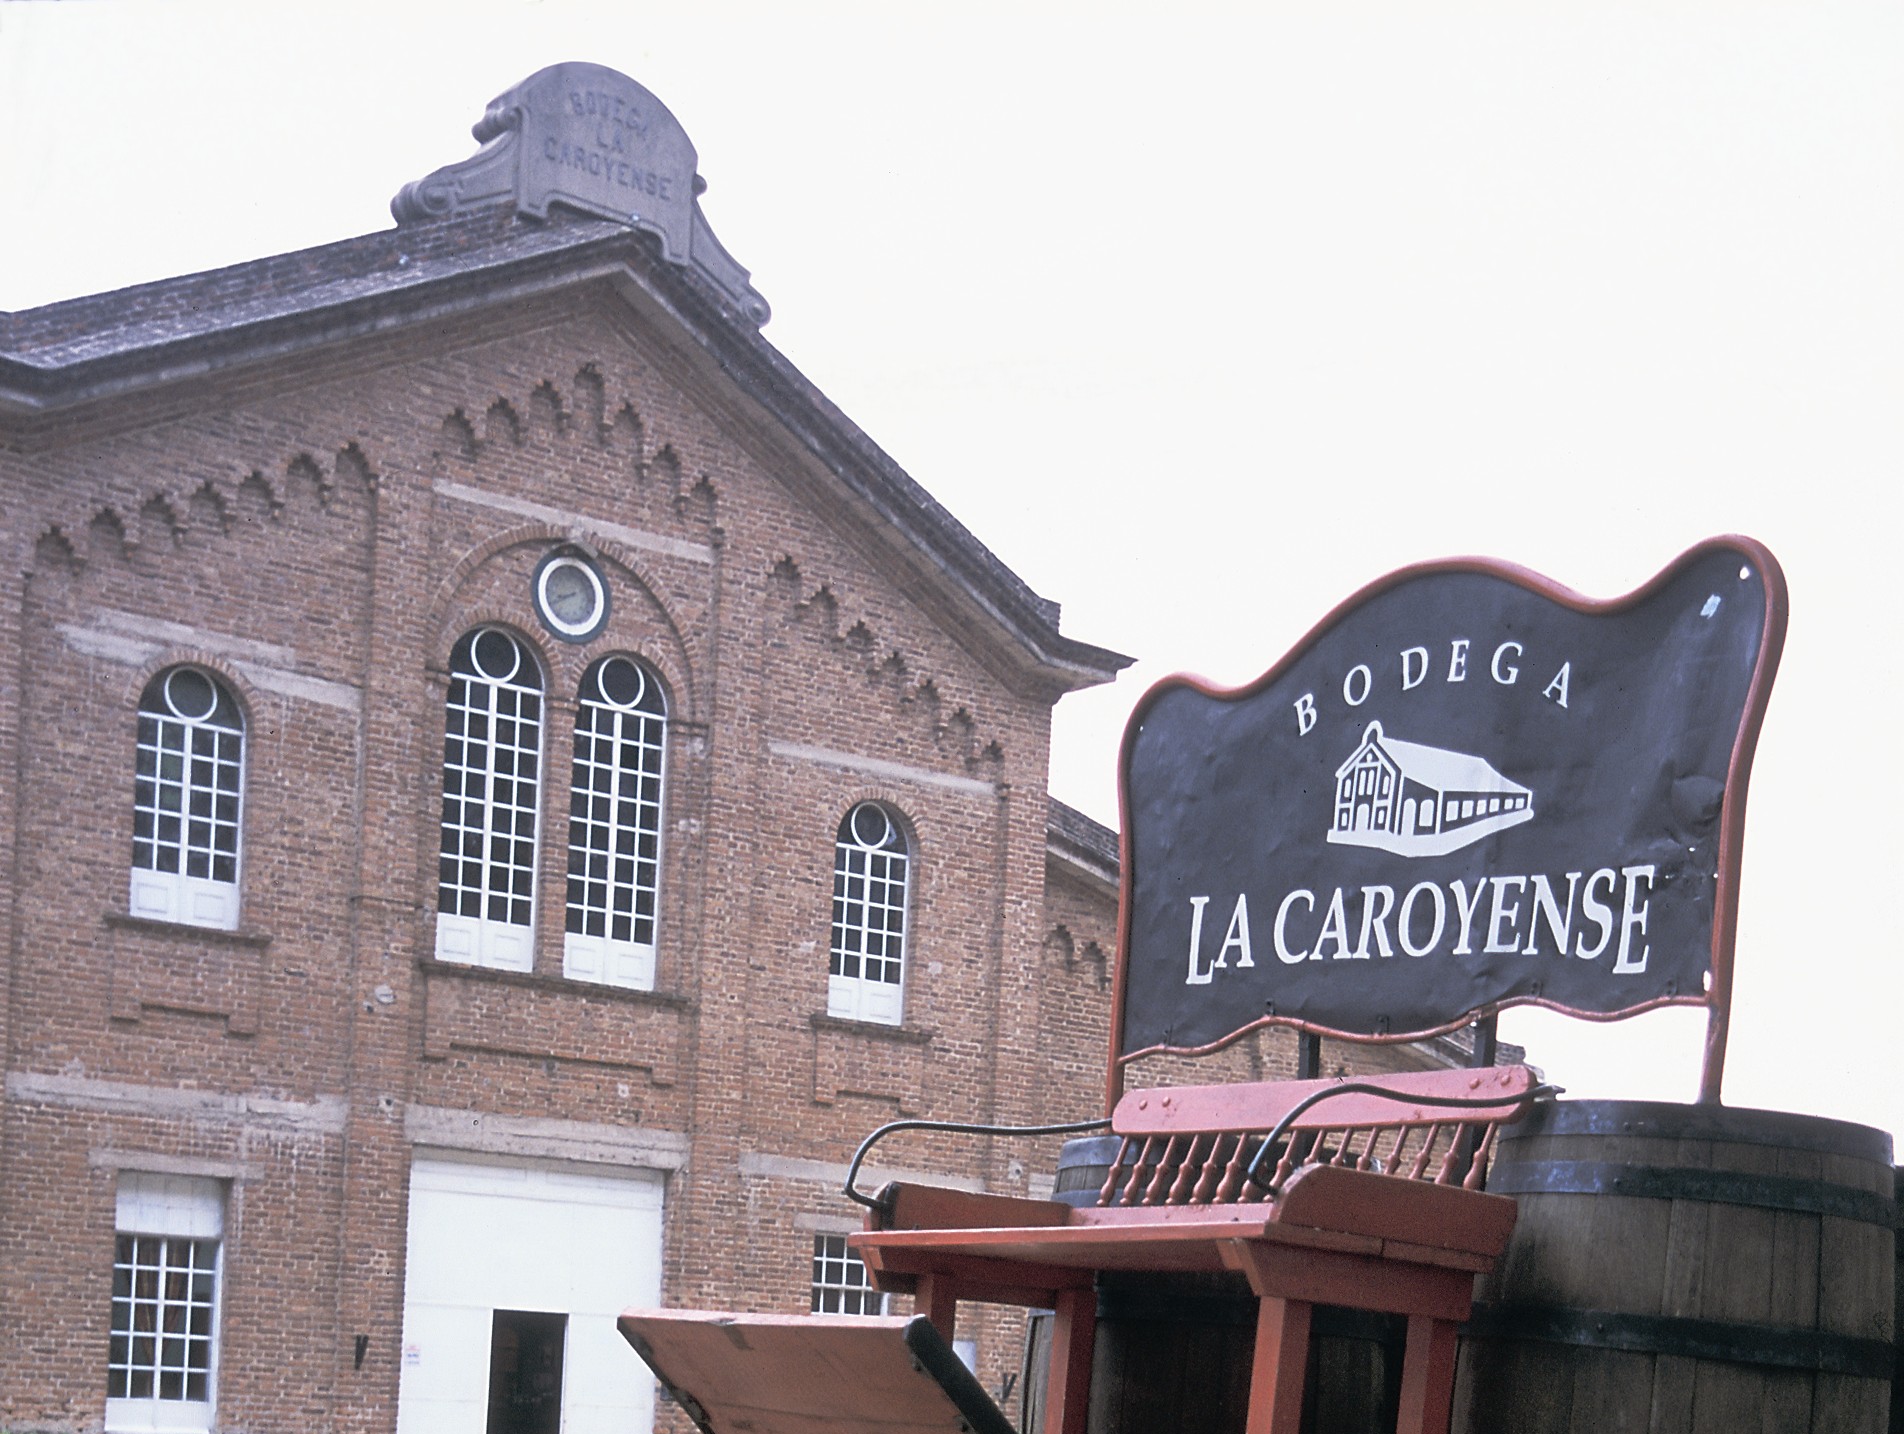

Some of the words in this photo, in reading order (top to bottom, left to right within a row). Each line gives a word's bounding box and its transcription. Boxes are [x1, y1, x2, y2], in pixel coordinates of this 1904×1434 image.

[543, 135, 674, 202] CAROYENSE
[596, 121, 625, 154] LA
[1294, 640, 1571, 737] BODEGA
[1186, 893, 1255, 985] LA
[1273, 865, 1655, 975] CAROYENSE
